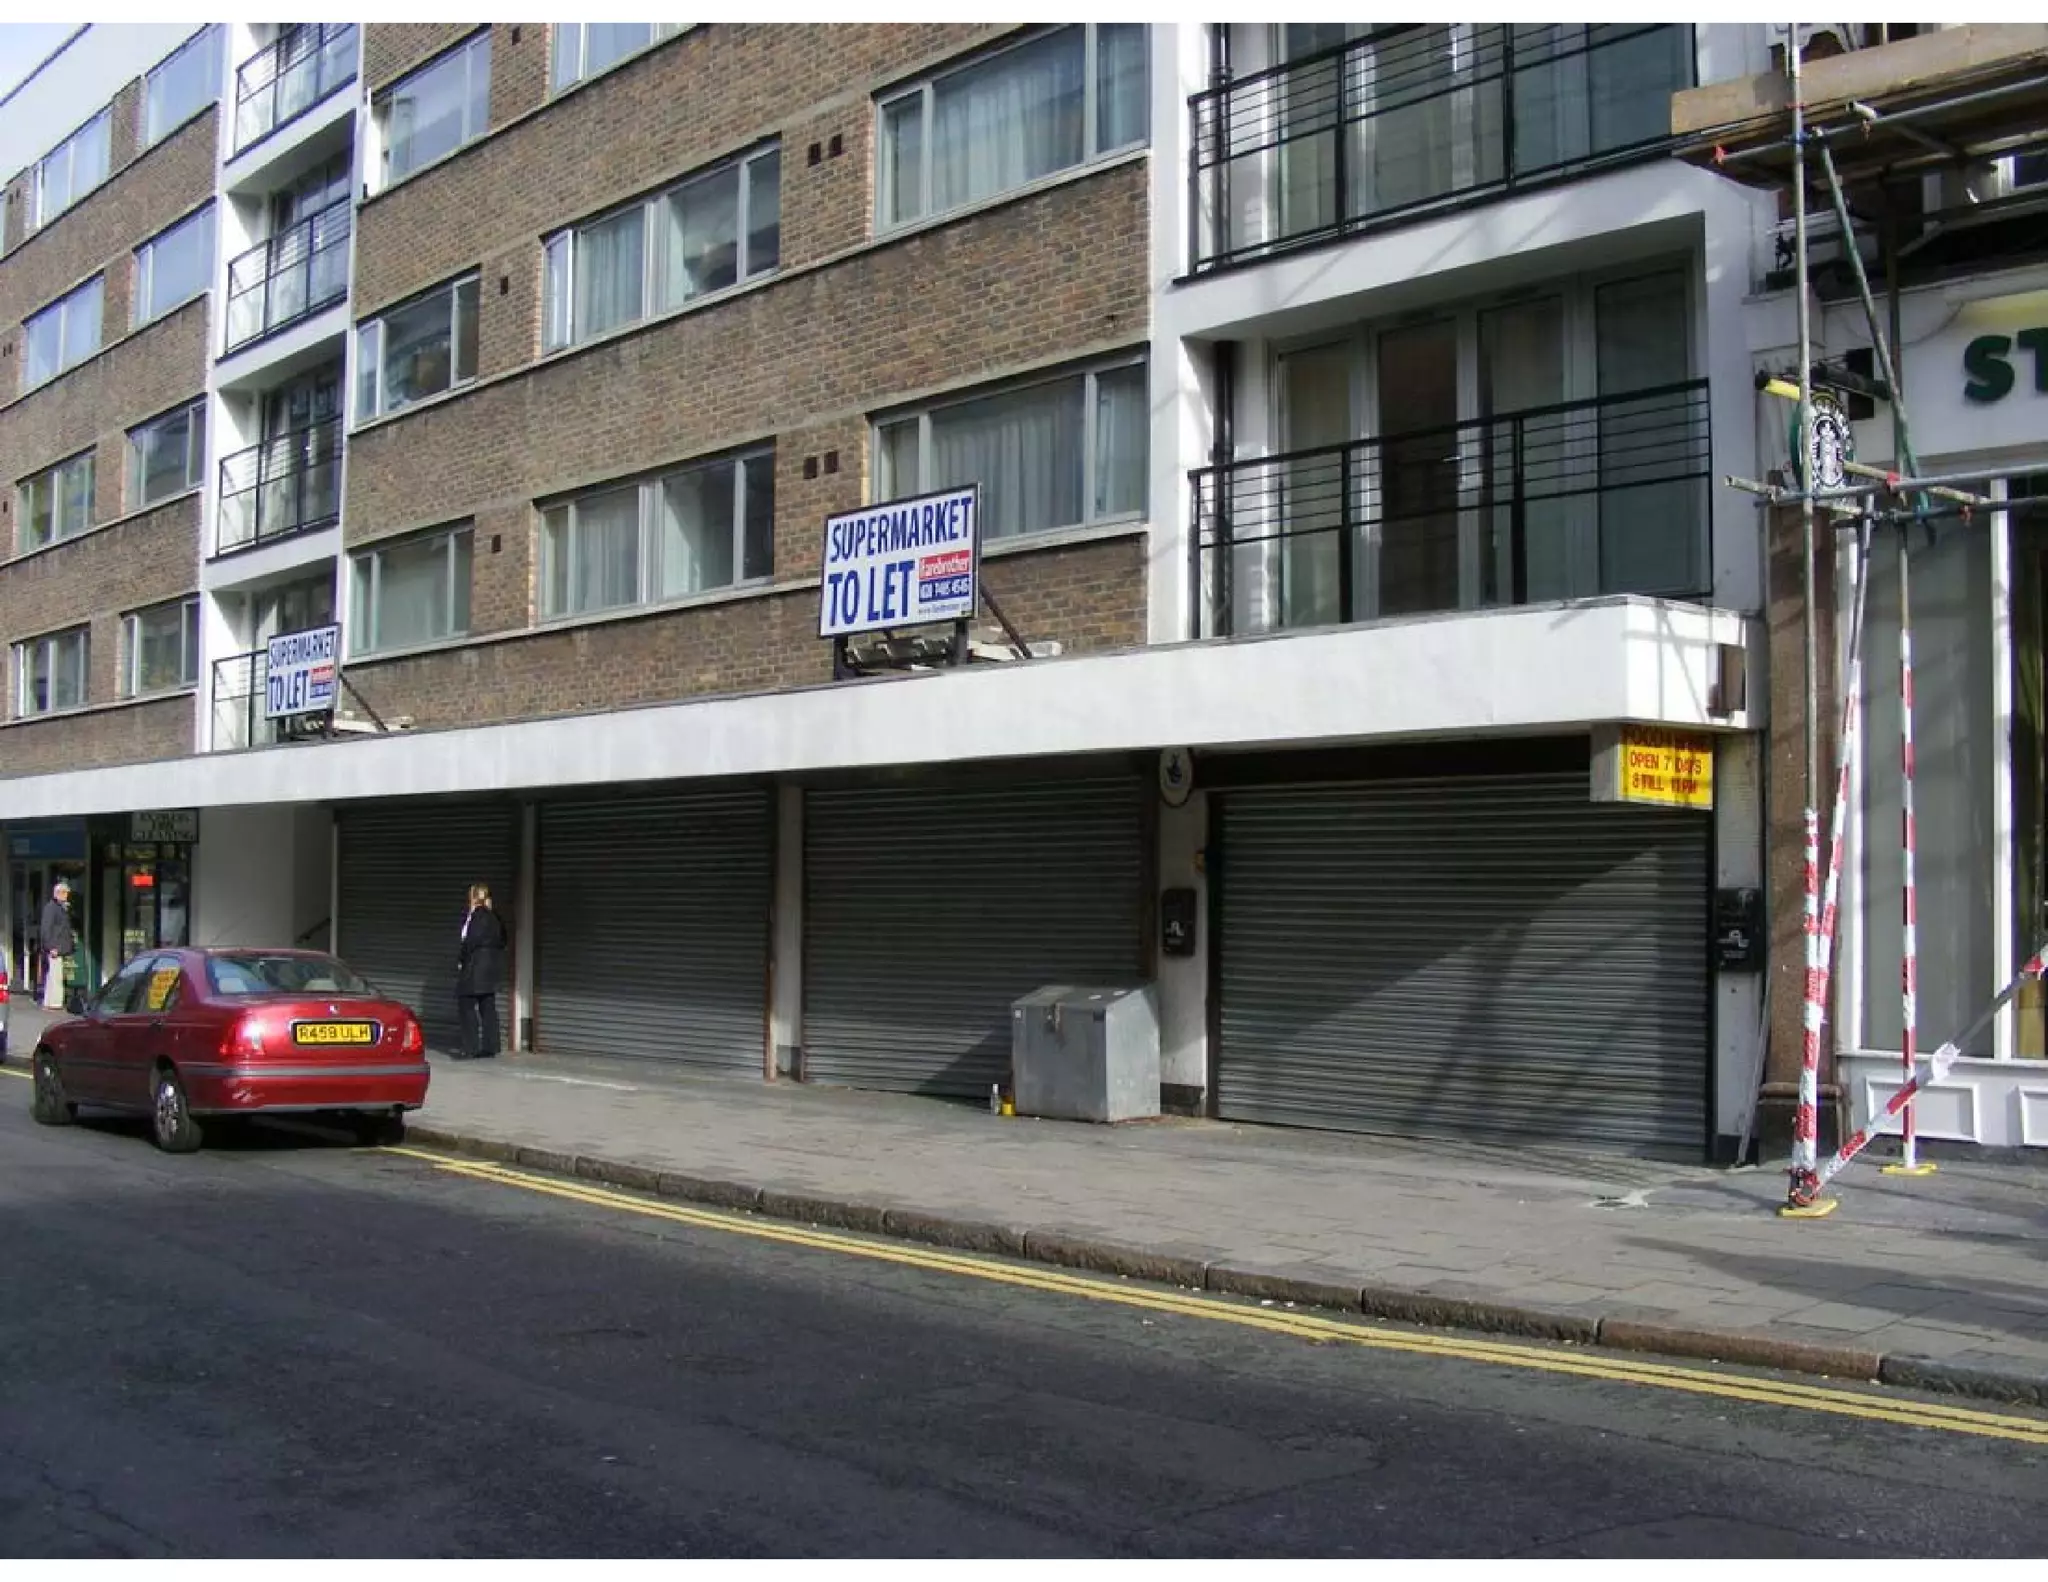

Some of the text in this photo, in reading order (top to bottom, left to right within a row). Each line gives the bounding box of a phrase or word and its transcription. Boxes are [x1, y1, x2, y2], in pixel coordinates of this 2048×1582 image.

[829, 497, 972, 563] SUPERMARKET
[828, 560, 914, 627] TO LET
[269, 630, 335, 669] SUPERMARKET
[268, 675, 285, 713] TO
[286, 669, 309, 709] LET
[1630, 749, 1702, 775] OPEN 7 DAYS
